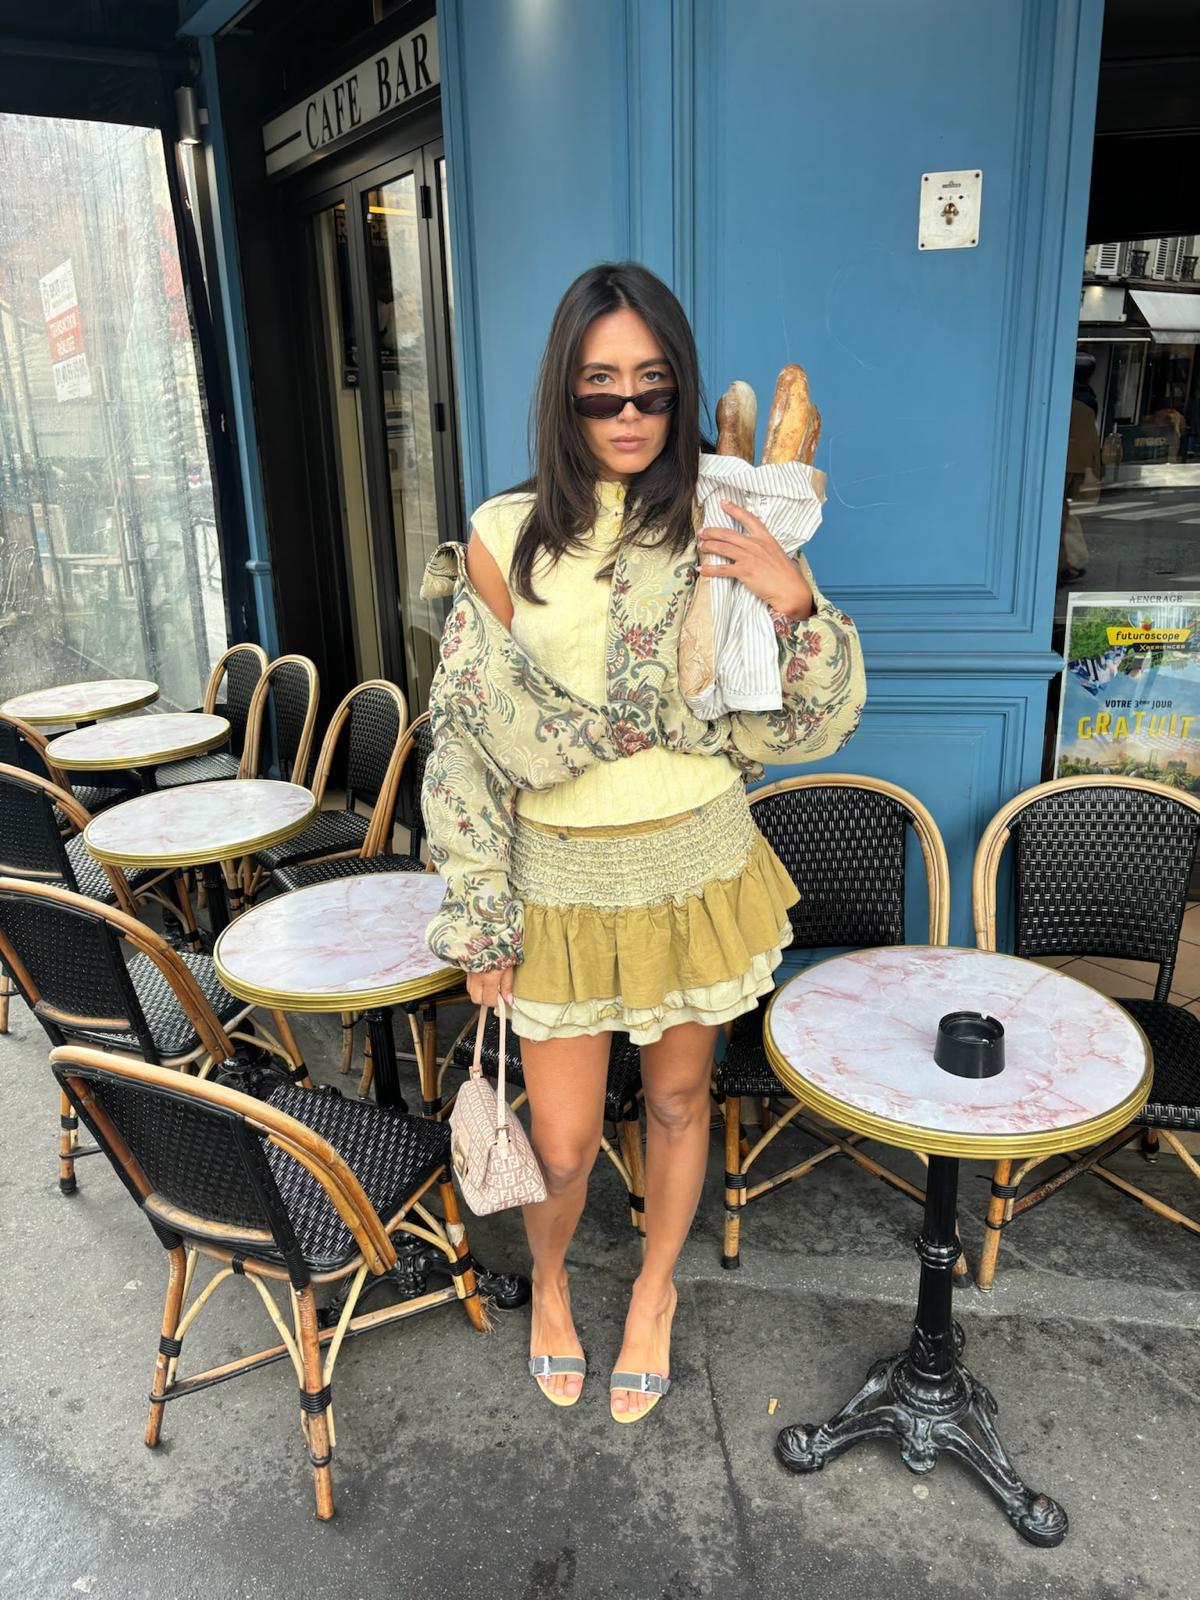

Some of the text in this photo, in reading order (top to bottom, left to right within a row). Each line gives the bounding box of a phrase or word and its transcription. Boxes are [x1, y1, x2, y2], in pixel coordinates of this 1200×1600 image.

[306, 33, 432, 150] CAFE BAR
[1116, 630, 1180, 641] futuroscope
[1105, 700, 1132, 708] VOTRE
[1152, 700, 1173, 709] JOUR
[1077, 711, 1196, 740] GRATUIT
